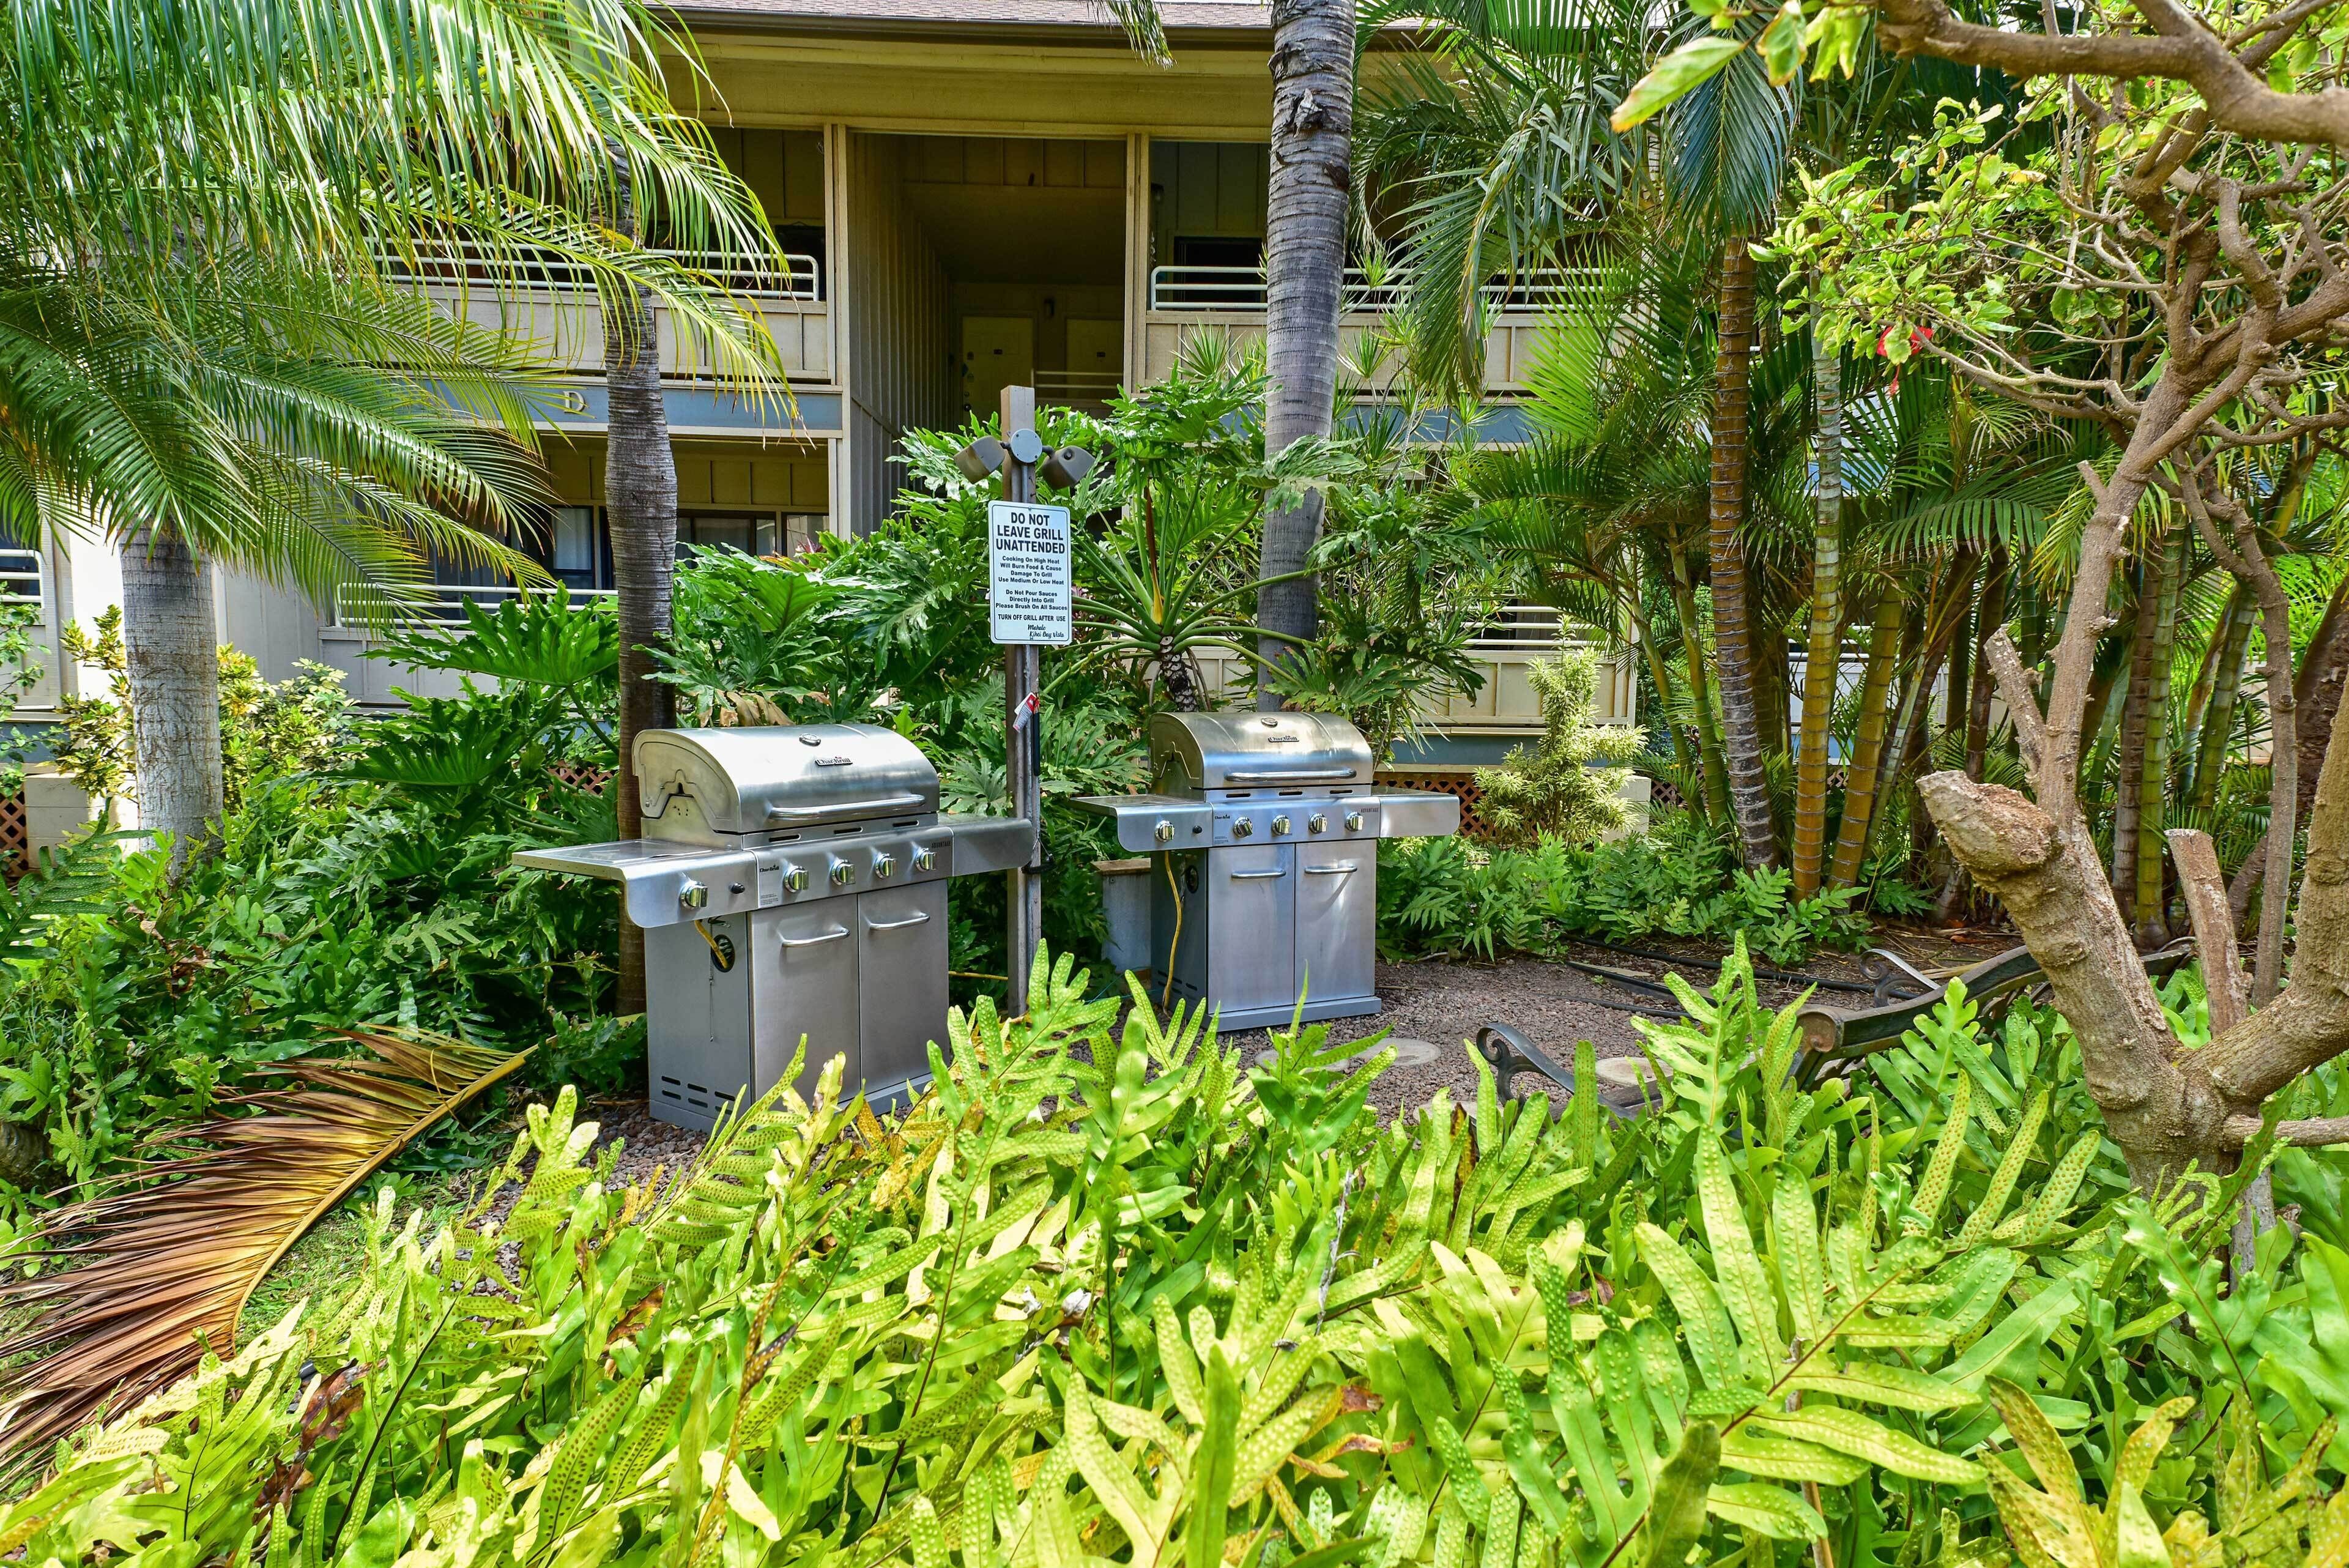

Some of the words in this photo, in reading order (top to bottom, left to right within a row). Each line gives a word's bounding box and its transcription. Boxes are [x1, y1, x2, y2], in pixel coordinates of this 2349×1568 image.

[563, 391, 585, 413] D
[1011, 512, 1025, 524] DO
[1029, 514, 1050, 526] NOT
[997, 525, 1030, 538] LEAVE
[1034, 527, 1063, 541] GRILL
[996, 538, 1065, 554] UNATTENDED
